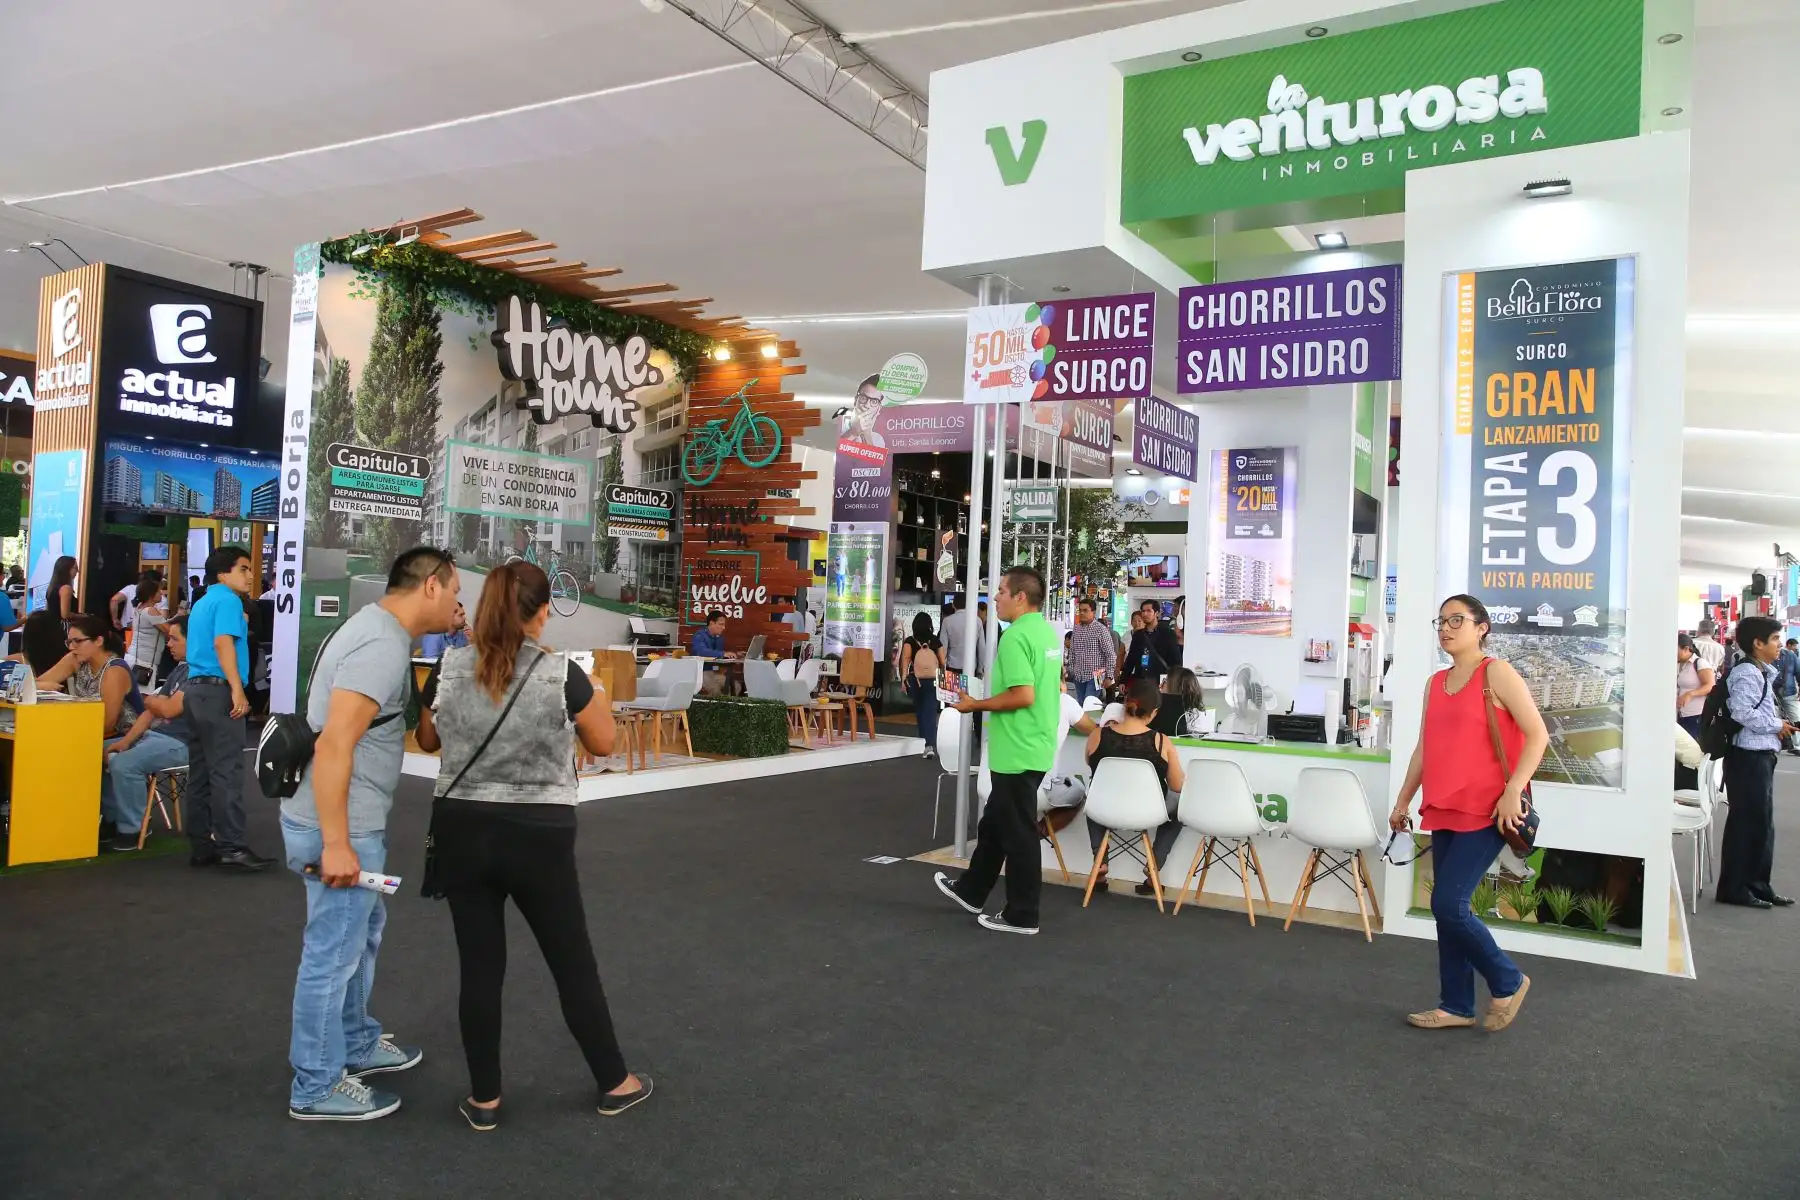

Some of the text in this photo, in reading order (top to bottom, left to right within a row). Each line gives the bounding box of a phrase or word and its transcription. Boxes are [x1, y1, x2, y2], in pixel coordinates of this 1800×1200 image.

[1267, 74, 1308, 113] la
[1183, 67, 1548, 166] venturosa
[1262, 125, 1547, 181] INMOBILIARIA
[1535, 281, 1601, 292] CONDOMINIO
[1187, 277, 1387, 330] CHORRILLOS
[1487, 295, 1541, 318] Bella
[1066, 303, 1149, 342] LINCE
[1526, 316, 1564, 325] SURCO
[972, 330, 1006, 369] 50
[1006, 336, 1028, 354] MIL
[1516, 342, 1567, 362] SURCO
[36, 351, 92, 392] actual
[891, 363, 918, 373] COMPRA
[1187, 338, 1369, 385] SAN ISIDRO
[1053, 356, 1147, 394] SURCO
[35, 385, 90, 413] inmobiliaria
[121, 368, 235, 409] actual
[1485, 367, 1596, 418] GRAN
[120, 394, 233, 427] inmobiliaria
[1139, 397, 1194, 444] CHORRILLOS
[886, 416, 965, 431] CHORRILLOS
[1073, 406, 1111, 449] SURCO
[1484, 422, 1599, 446] LANZAMIENTO
[109, 442, 144, 454] MIGUEL
[152, 448, 206, 461] CHORRILLOS
[281, 409, 308, 519] Borja
[337, 448, 420, 476] Capítulo 1
[860, 448, 884, 460] OFERTA
[1141, 434, 1192, 477] SAN ISIDRO
[362, 473, 396, 485] COMUNES
[397, 480, 418, 488] LISTAS
[463, 456, 575, 483] VIVE LA EXPERIENCIA
[1237, 474, 1273, 482] CHORRILLOS
[334, 488, 419, 506] DEPARTAMENTOS LISTOS
[356, 481, 401, 492] PARA USARSE
[463, 473, 577, 498] DE UN CONDOMINIO
[612, 487, 667, 507] Capítulo 2
[1014, 491, 1054, 505] SALIDA
[1262, 492, 1278, 504] MIL
[333, 501, 420, 518] ENTREGA INMEDIATA
[481, 492, 559, 512] EN SAN BORJA
[1236, 486, 1262, 511] 20
[1481, 450, 1598, 566] ETAPA 3
[276, 540, 297, 614] San
[697, 560, 742, 571] RECORRE
[691, 574, 767, 604] vuelve
[1482, 572, 1595, 590] VISTA PARQUE
[692, 601, 702, 614] a
